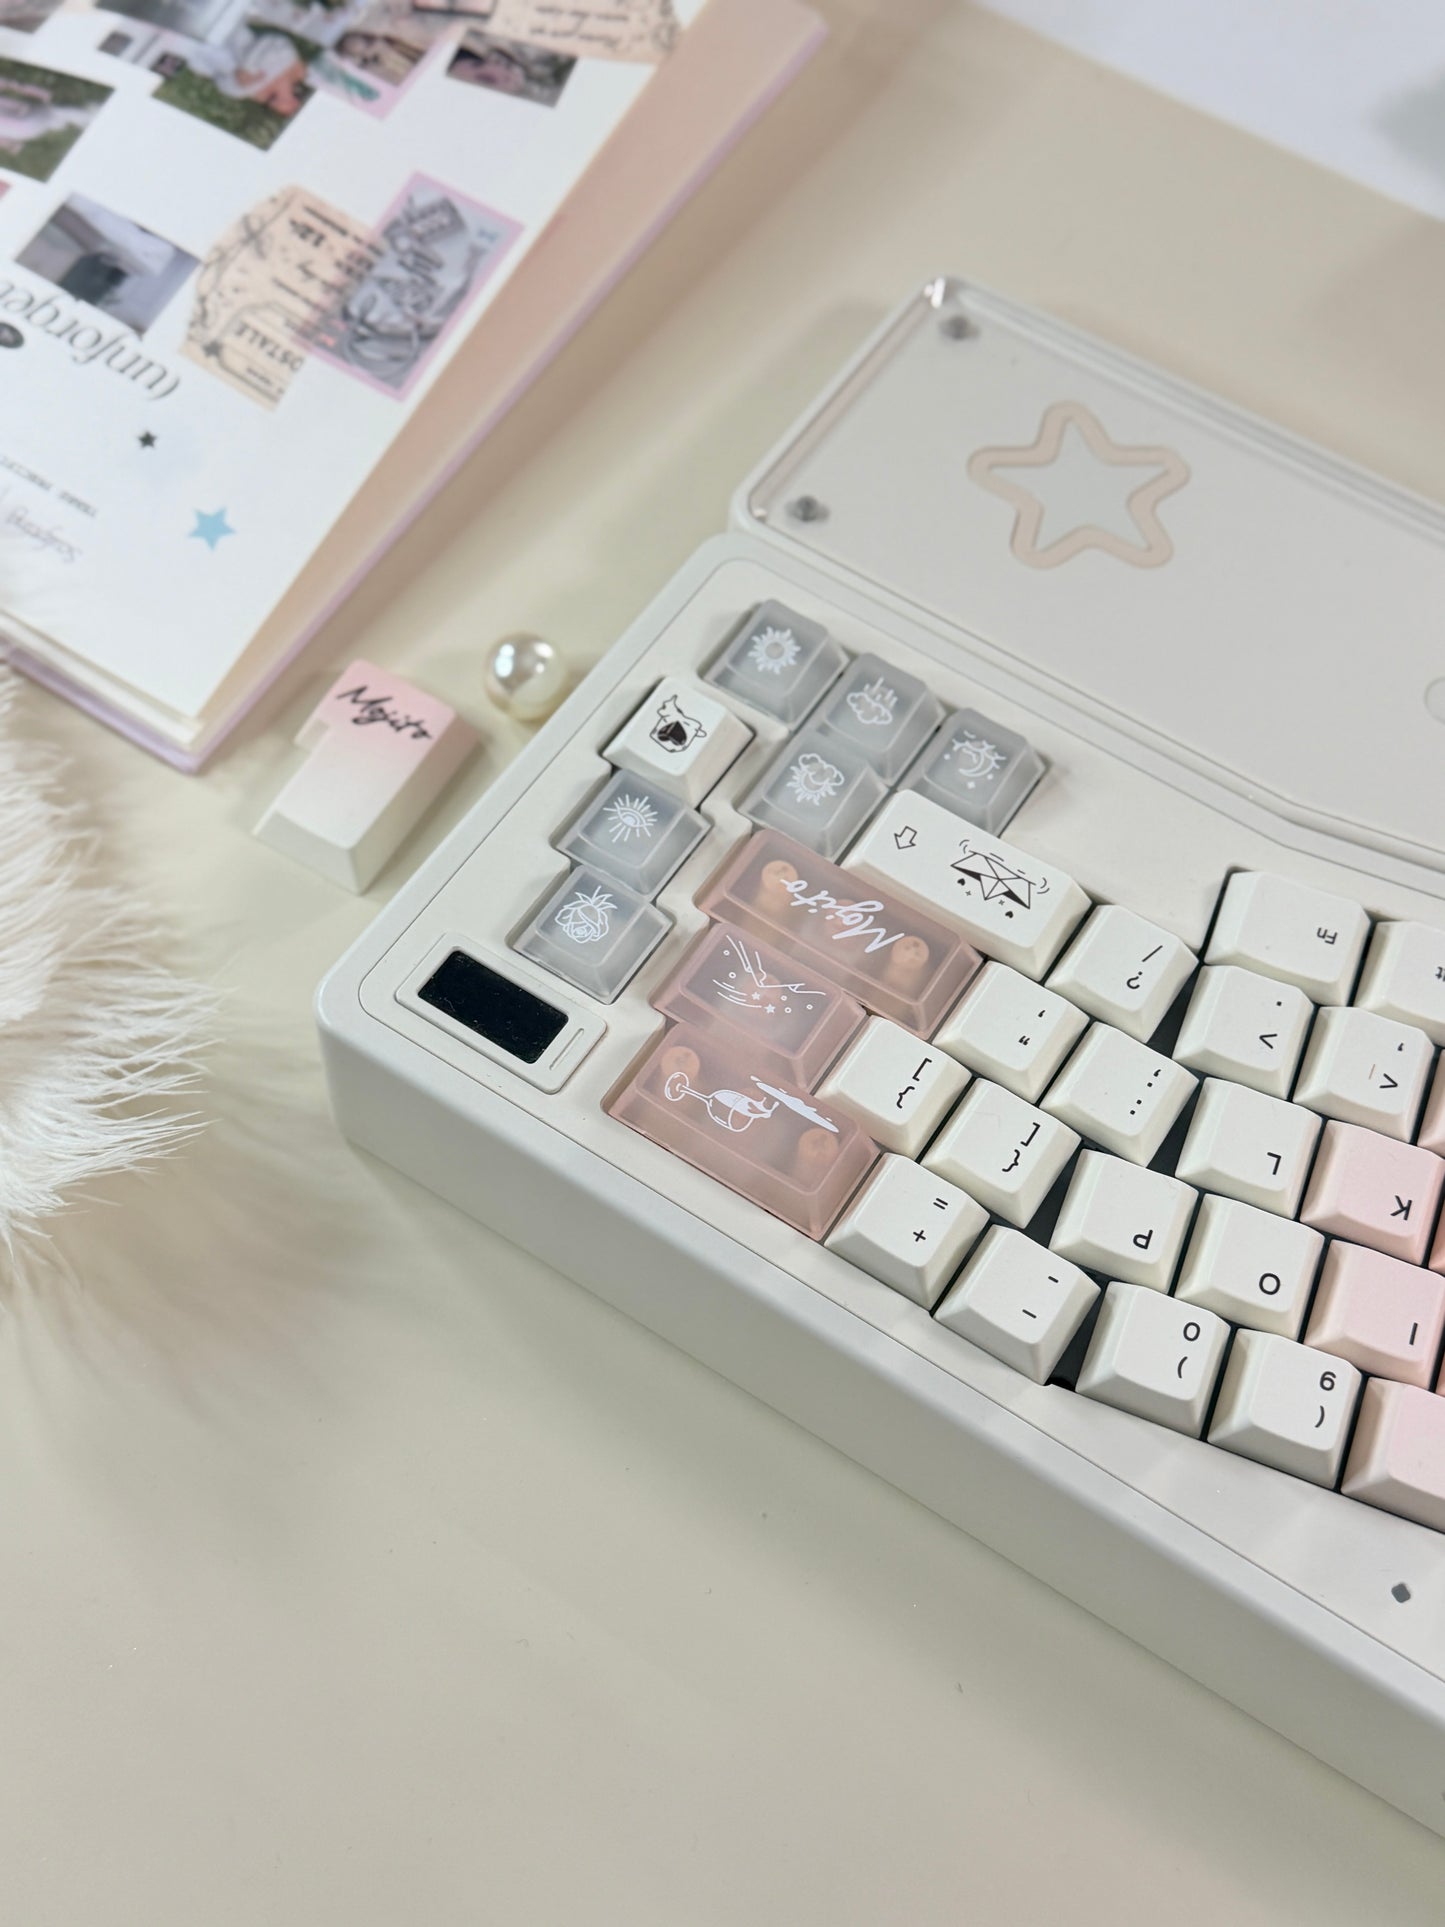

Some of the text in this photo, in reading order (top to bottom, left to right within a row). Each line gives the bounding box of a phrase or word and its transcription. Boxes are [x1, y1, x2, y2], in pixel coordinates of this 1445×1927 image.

[336, 684, 433, 740] Mojito
[779, 878, 906, 954] Mojito
[1316, 927, 1338, 945] Fn
[1126, 969, 1141, 990] ?
[1258, 1033, 1278, 1050] >
[1379, 1072, 1399, 1089] <
[1266, 1151, 1282, 1176] L
[1389, 1194, 1413, 1221] K
[912, 1229, 927, 1243] +
[1132, 1229, 1154, 1250] P
[1258, 1272, 1282, 1296] O
[1182, 1321, 1201, 1342] 0
[1408, 1322, 1419, 1346] I
[1319, 1370, 1337, 1392] 9
